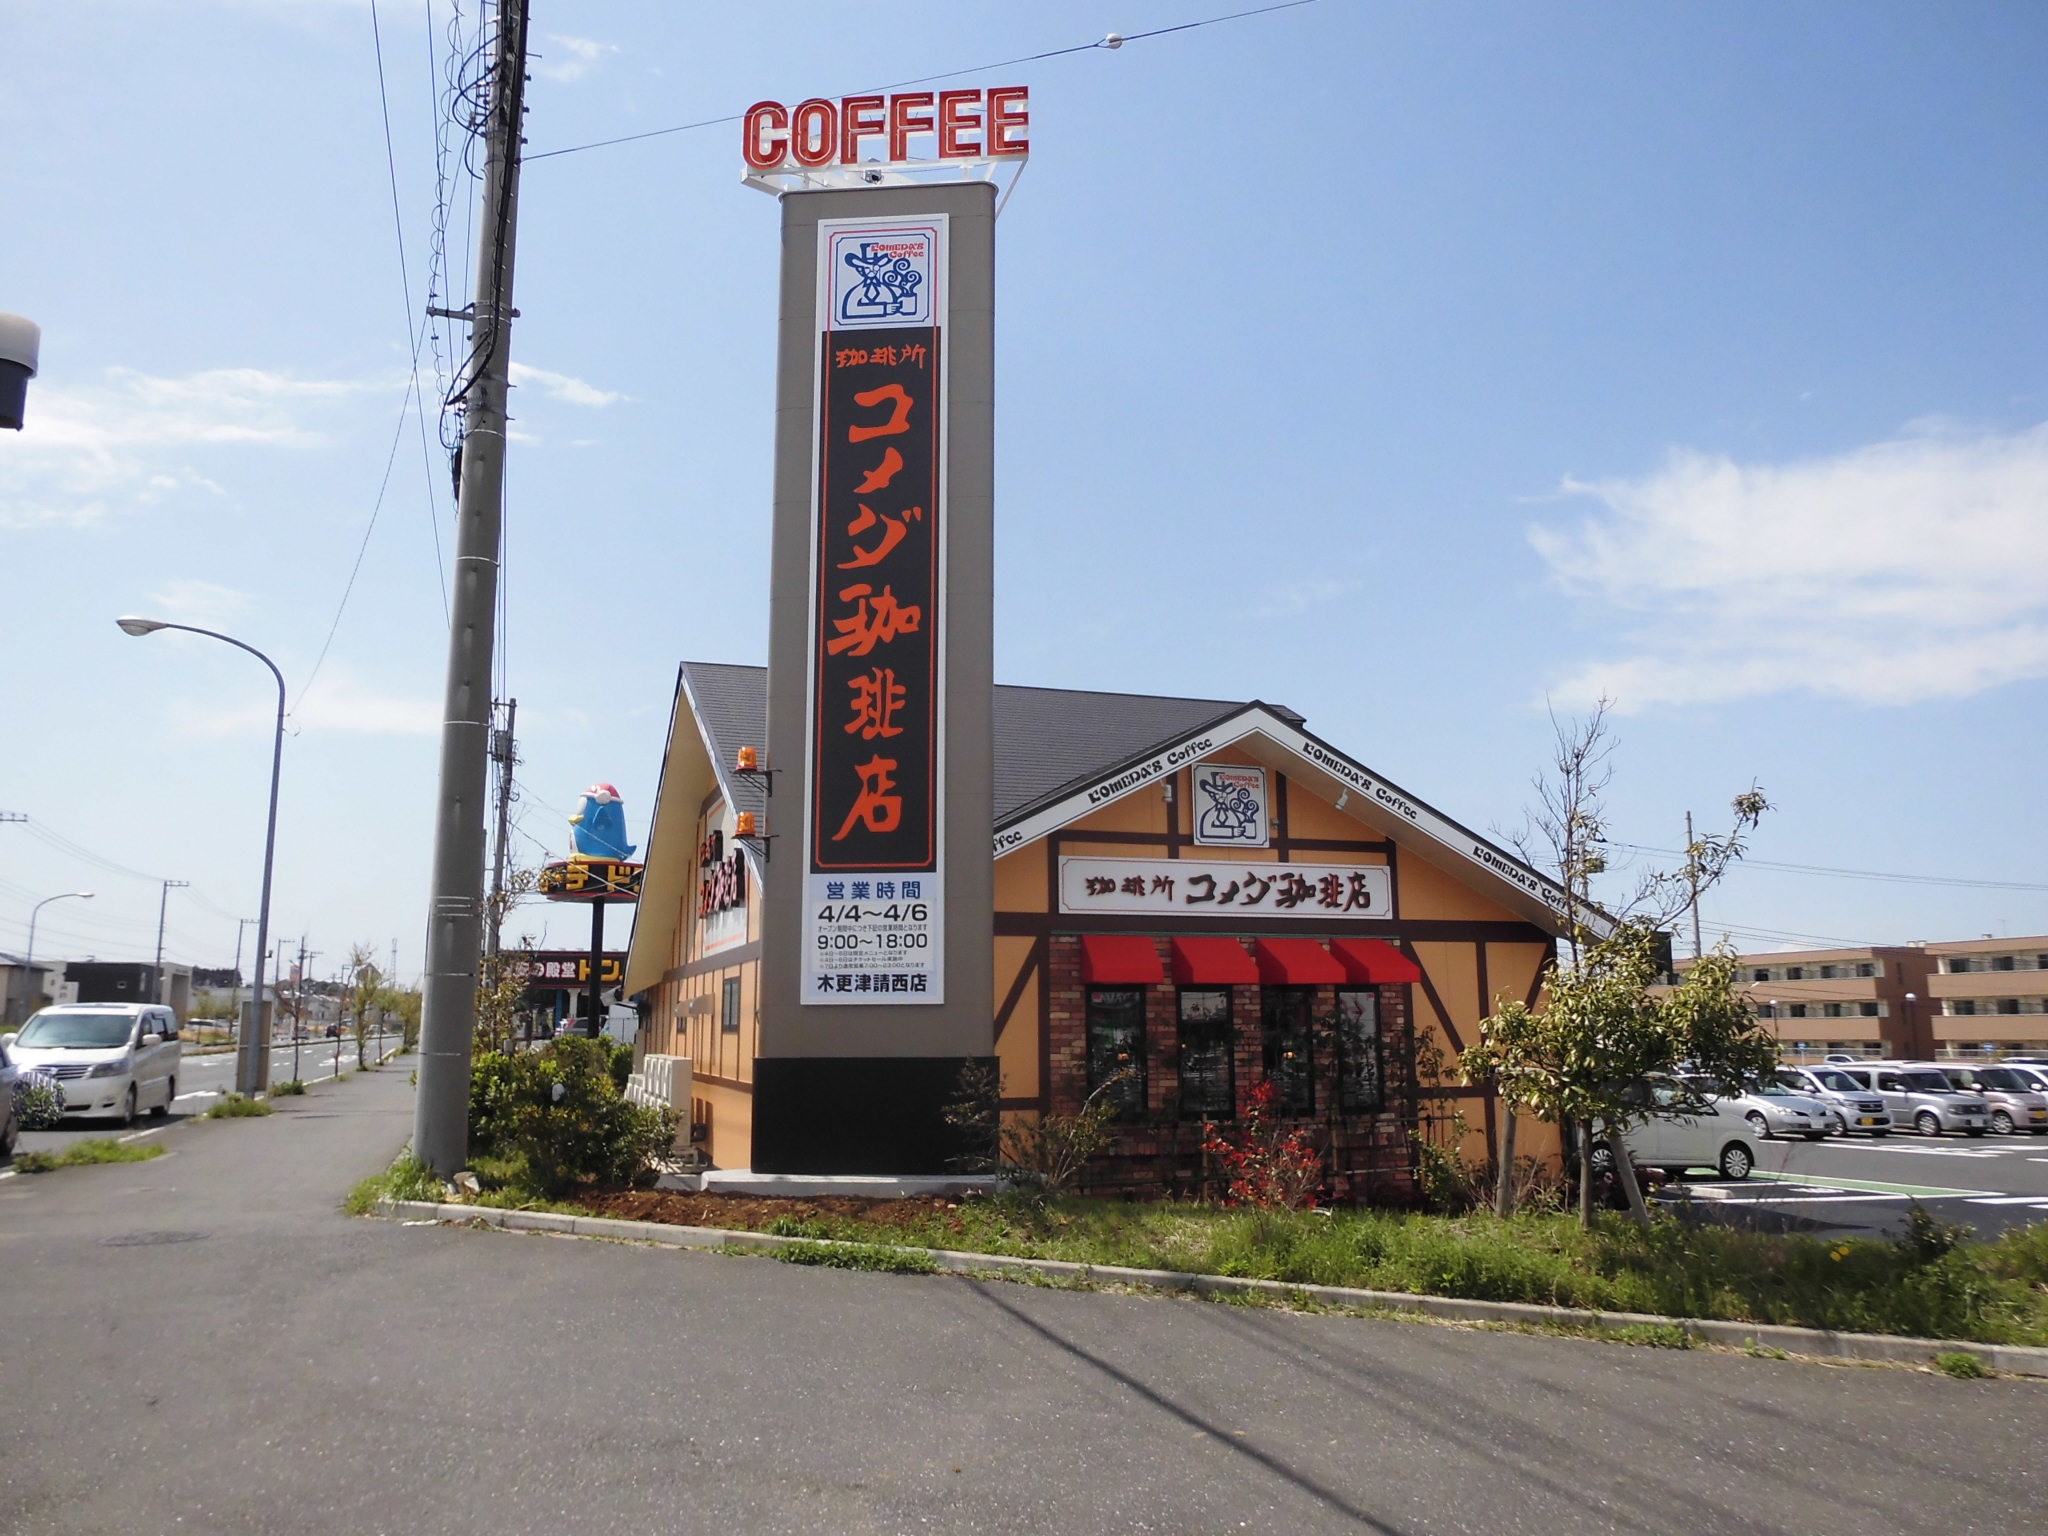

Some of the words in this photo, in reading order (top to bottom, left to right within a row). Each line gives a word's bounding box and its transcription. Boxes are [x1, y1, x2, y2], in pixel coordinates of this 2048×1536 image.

[742, 86, 1030, 170] COFFEE
[835, 343, 927, 369] 珈琲所
[824, 383, 922, 841] コメダ珈琲店
[1088, 760, 1163, 804] KOMEDA'S
[1167, 738, 1213, 765] Coffee
[1302, 741, 1372, 791] KOMEDA'S
[1375, 787, 1418, 820] Coffee
[993, 830, 1023, 852] ffee
[1085, 874, 1174, 901] 珈琲所
[1472, 845, 1538, 891] KOMEDA'S
[826, 881, 921, 900] 営業時間
[1186, 870, 1371, 912] コメダ珈琲店
[817, 973, 928, 993] 木更津請西店
